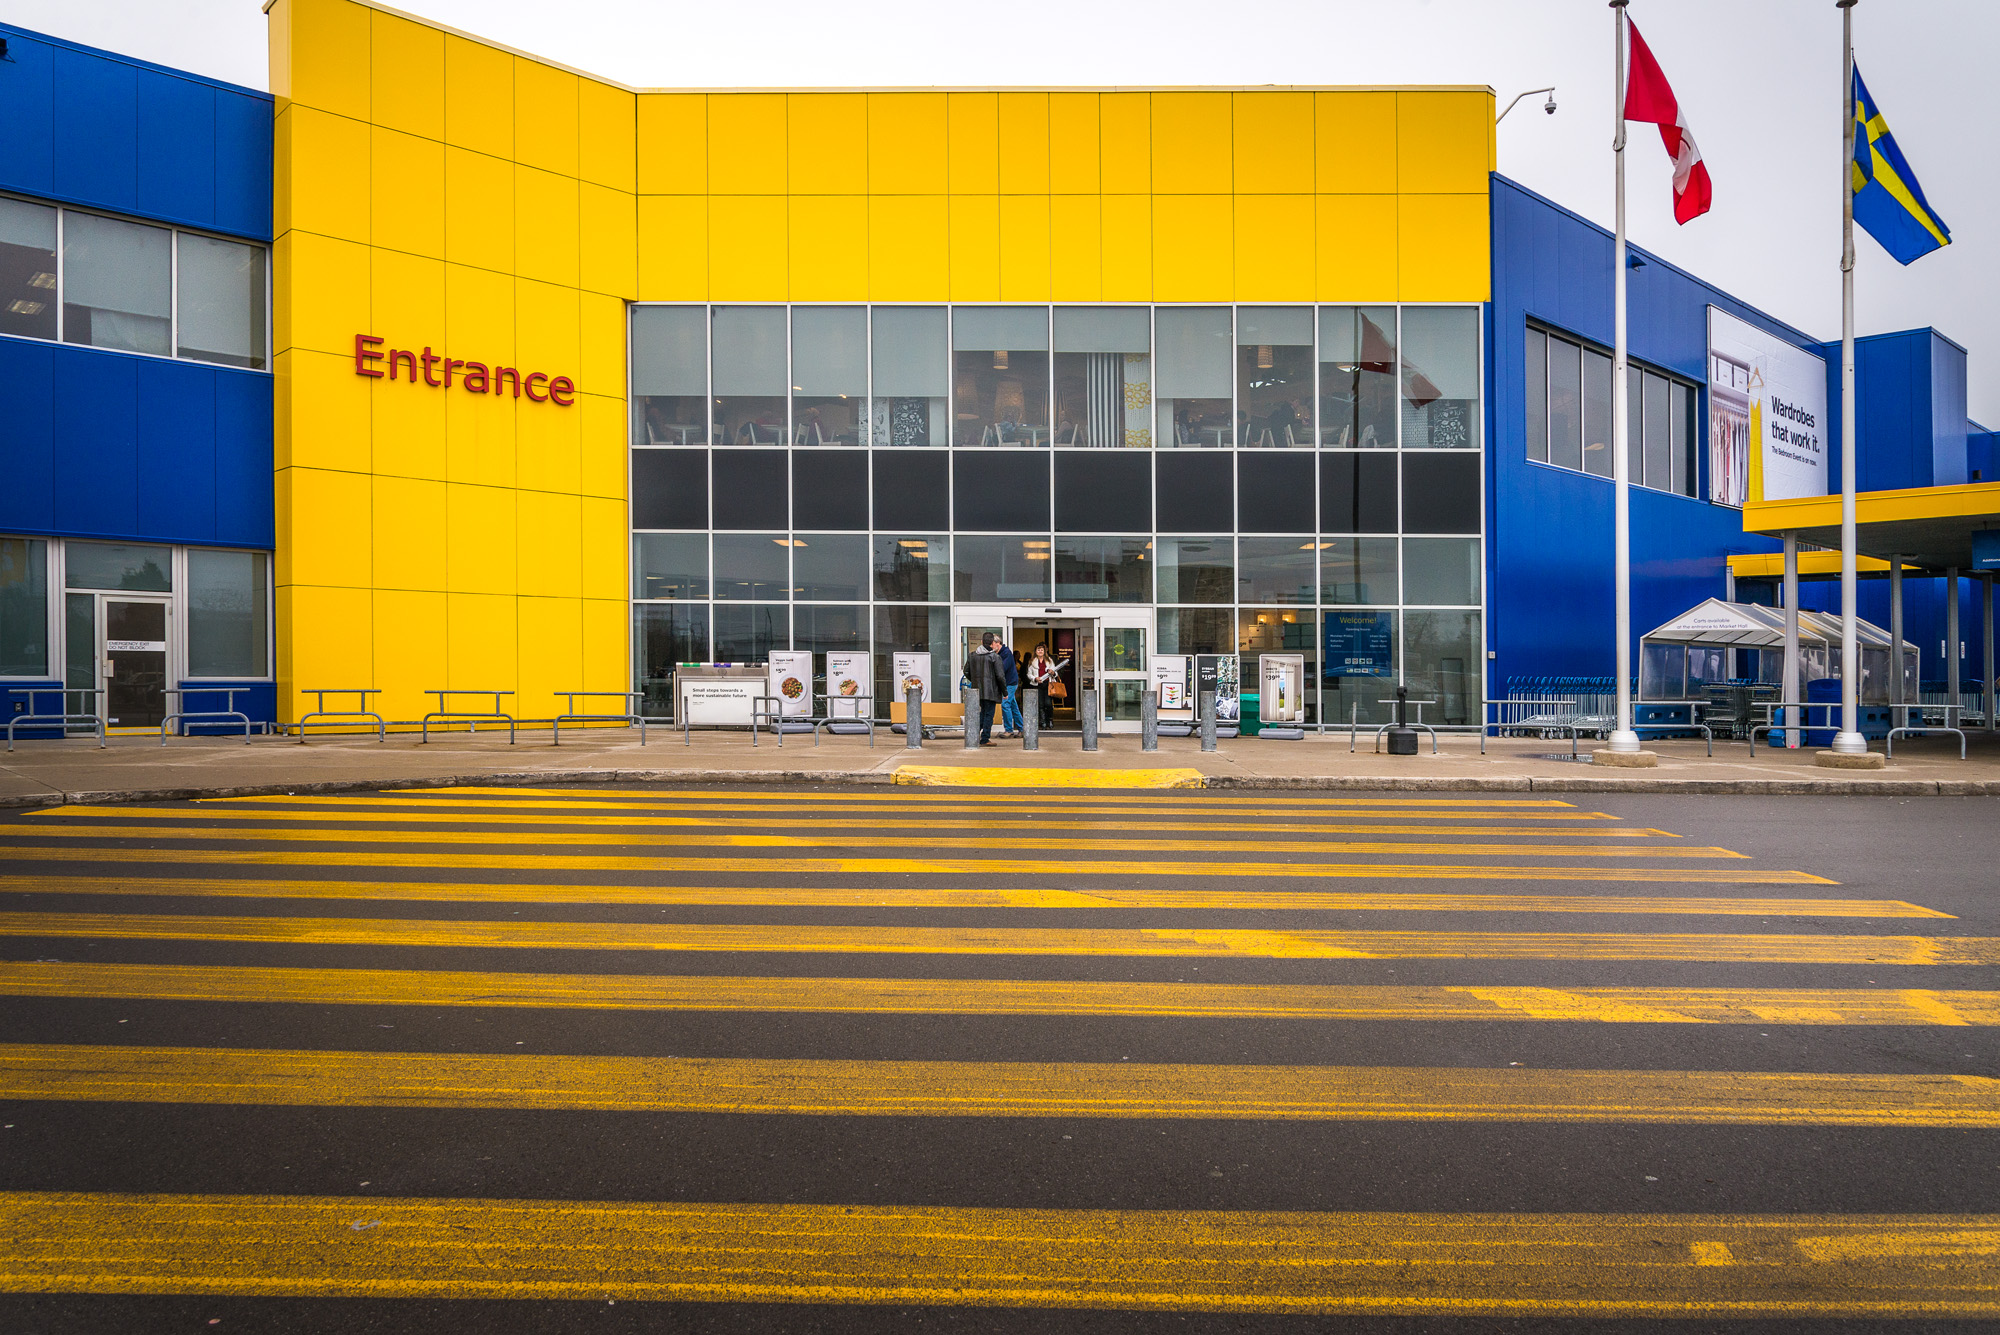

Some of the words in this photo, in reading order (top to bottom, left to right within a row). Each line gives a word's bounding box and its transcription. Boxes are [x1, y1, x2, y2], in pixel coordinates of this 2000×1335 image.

[355, 333, 574, 405] Entrance
[1771, 395, 1815, 428] Wardrobes
[1771, 421, 1788, 443] that
[1790, 431, 1810, 450] work
[1812, 434, 1820, 453] it.
[1778, 448, 1792, 459] Bedroom
[1793, 452, 1802, 462] Event
[1339, 616, 1377, 624] Welcome!
